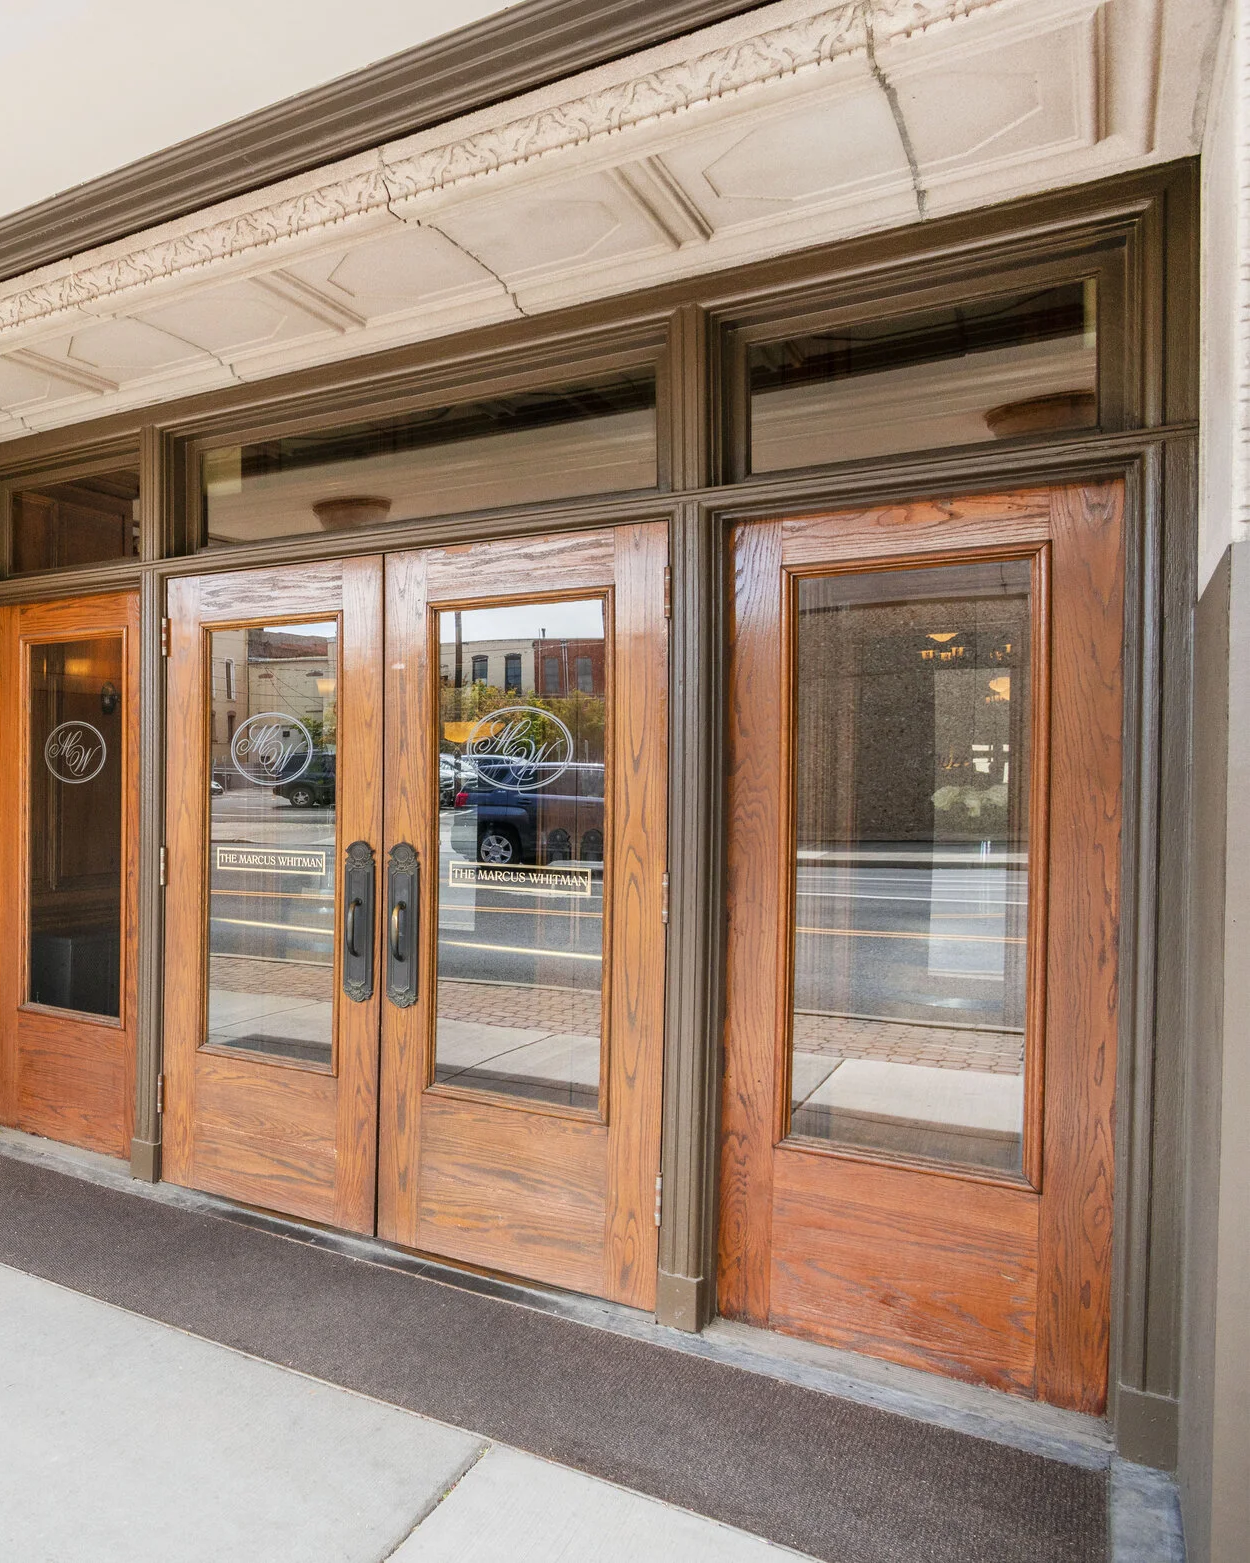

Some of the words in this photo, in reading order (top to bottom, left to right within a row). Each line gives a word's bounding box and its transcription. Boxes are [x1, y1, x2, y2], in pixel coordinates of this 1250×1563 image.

[220, 853, 237, 863] THE
[239, 854, 276, 866] MARCUS
[277, 856, 323, 868] WHITMAN
[452, 868, 476, 880] THE
[477, 870, 526, 882] MARCUS
[528, 872, 588, 887] WHITMAN
